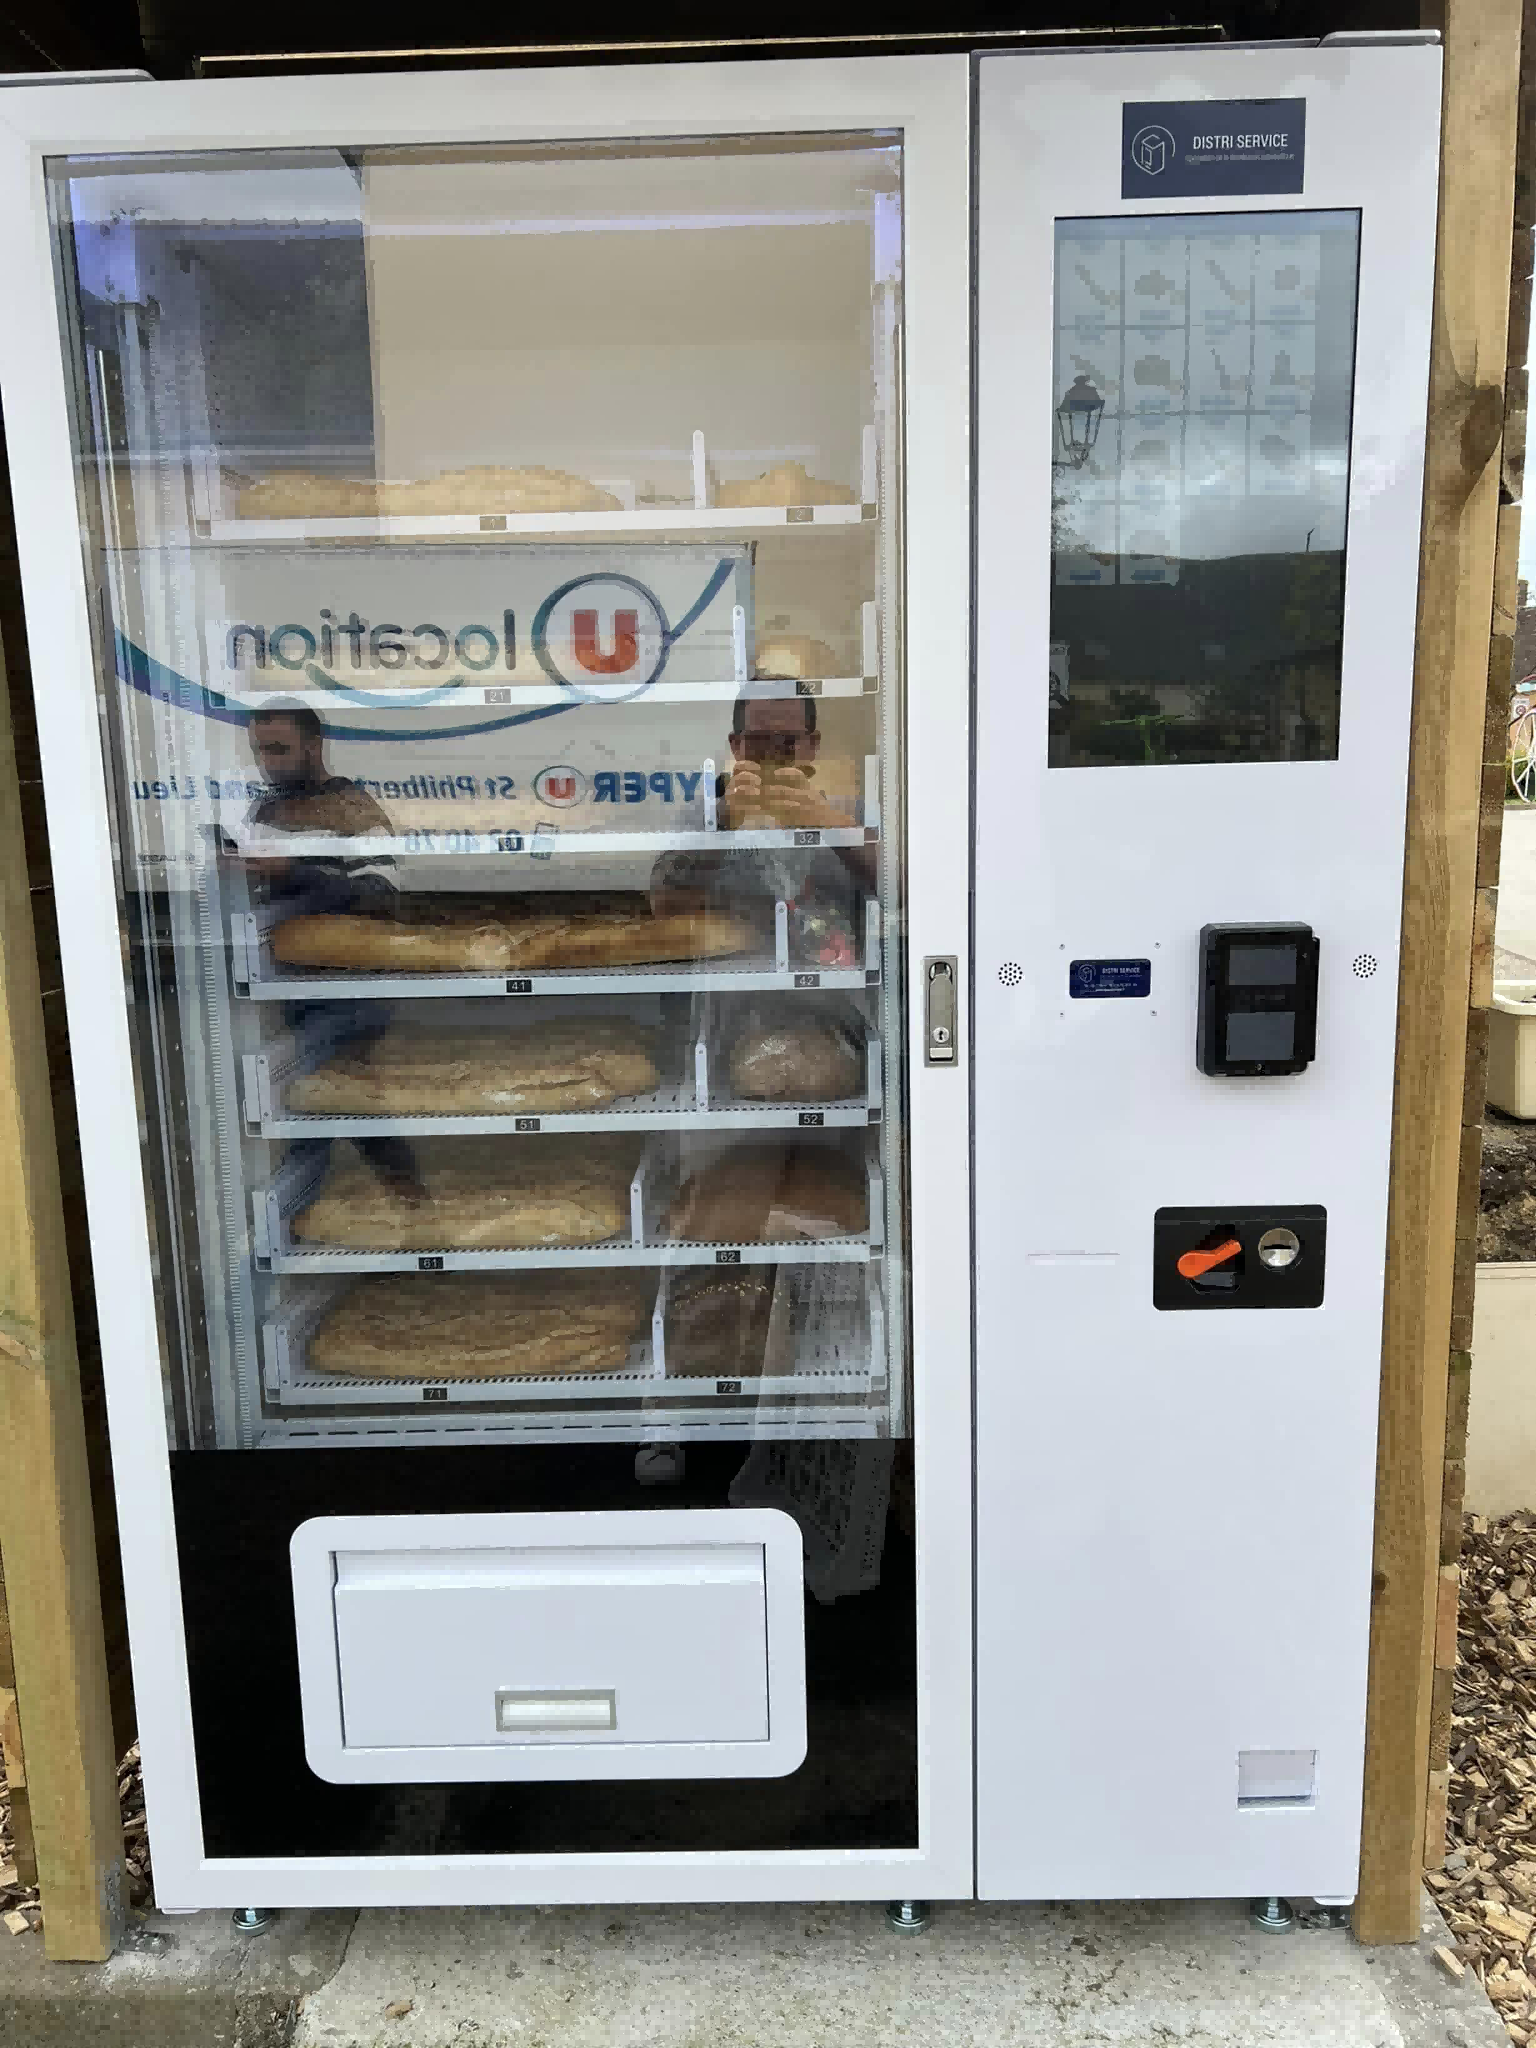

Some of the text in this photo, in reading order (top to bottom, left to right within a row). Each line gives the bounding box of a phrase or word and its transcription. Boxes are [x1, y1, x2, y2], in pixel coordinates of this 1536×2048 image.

[1192, 133, 1289, 150] DISTRI SERVICE
[799, 681, 818, 695] 22
[798, 832, 815, 845] 32
[510, 980, 527, 992] 41
[798, 975, 815, 987] 42
[518, 1118, 535, 1130] 51
[802, 1113, 819, 1125] 52
[422, 1257, 438, 1269] 61
[719, 1251, 737, 1263] 62
[719, 1381, 737, 1393] 72
[426, 1388, 443, 1400] 71
